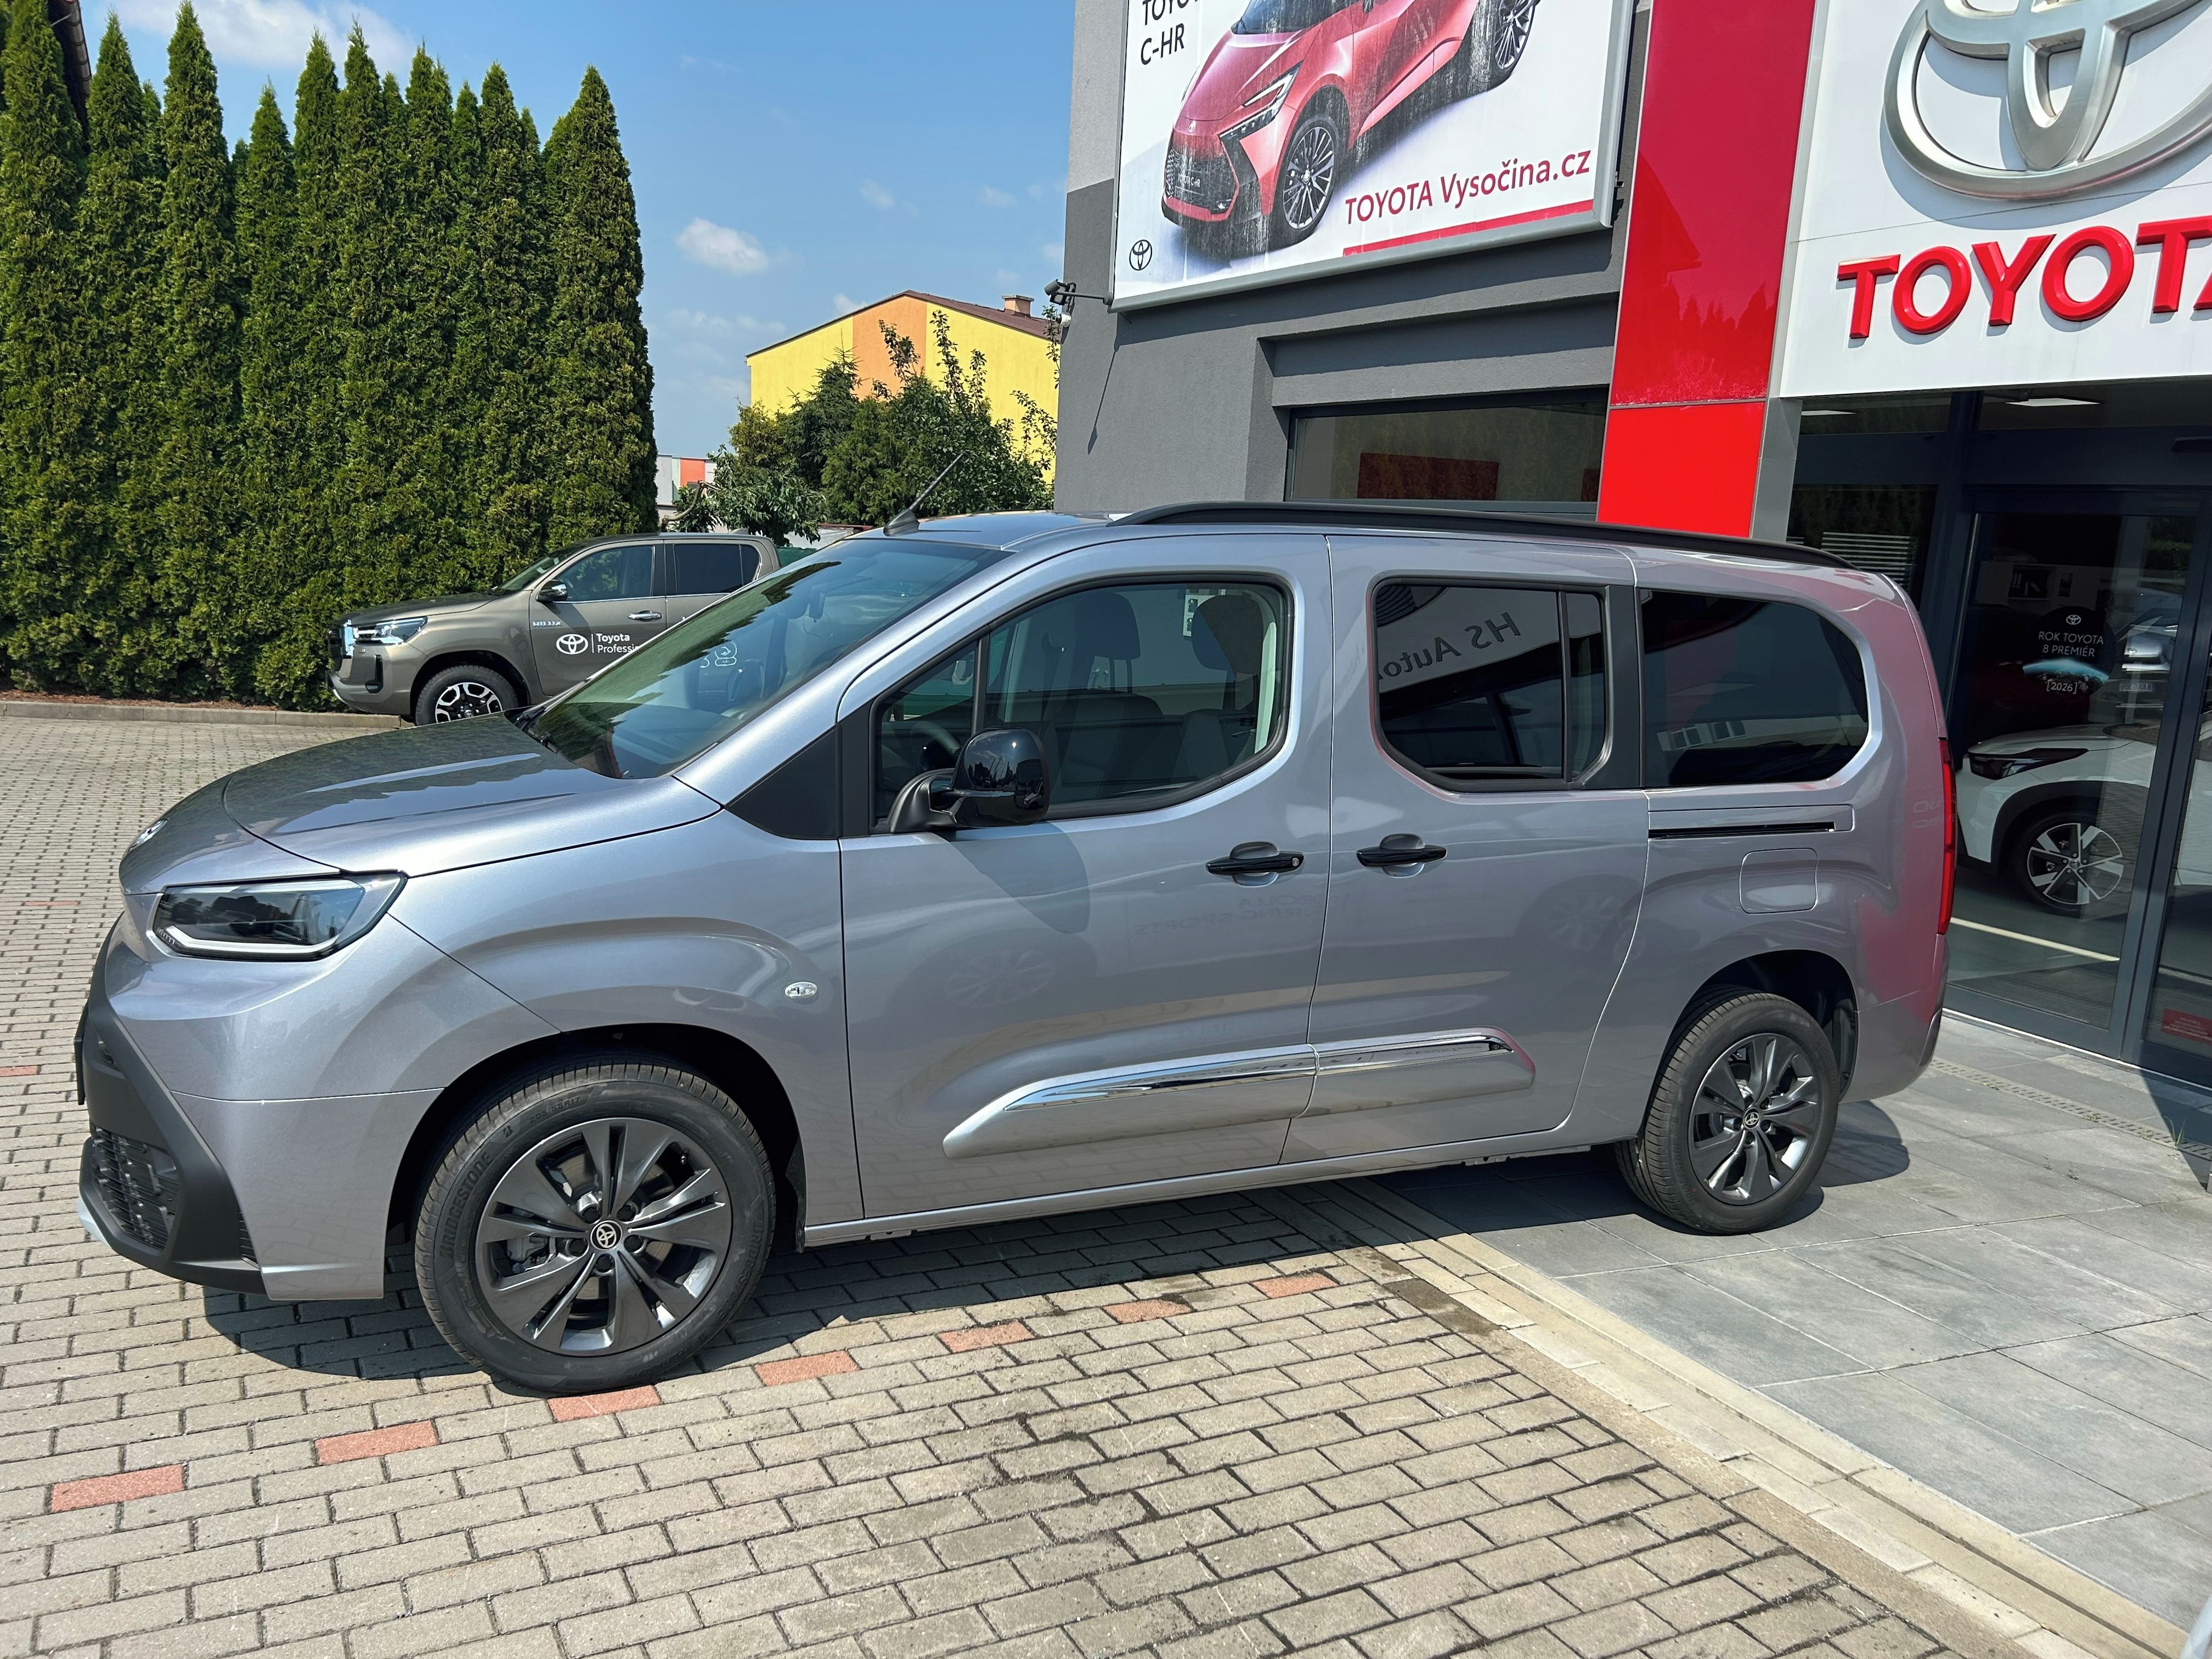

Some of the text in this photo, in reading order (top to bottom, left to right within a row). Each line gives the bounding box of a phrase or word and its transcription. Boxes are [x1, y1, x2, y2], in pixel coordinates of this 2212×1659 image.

[1141, 23, 1184, 65] C-HR
[1345, 150, 1592, 224] TOYOTA Vysočina.cz
[1837, 215, 2212, 340] TOYOT
[596, 633, 631, 644] Toyota
[2038, 631, 2104, 645] ROK TOYOTA
[2042, 644, 2095, 657] 8 PREMIÉR
[2046, 679, 2078, 695] [2026]
[528, 1096, 580, 1124] 205/55R17
[439, 1151, 493, 1260] BRIDGESTONE
